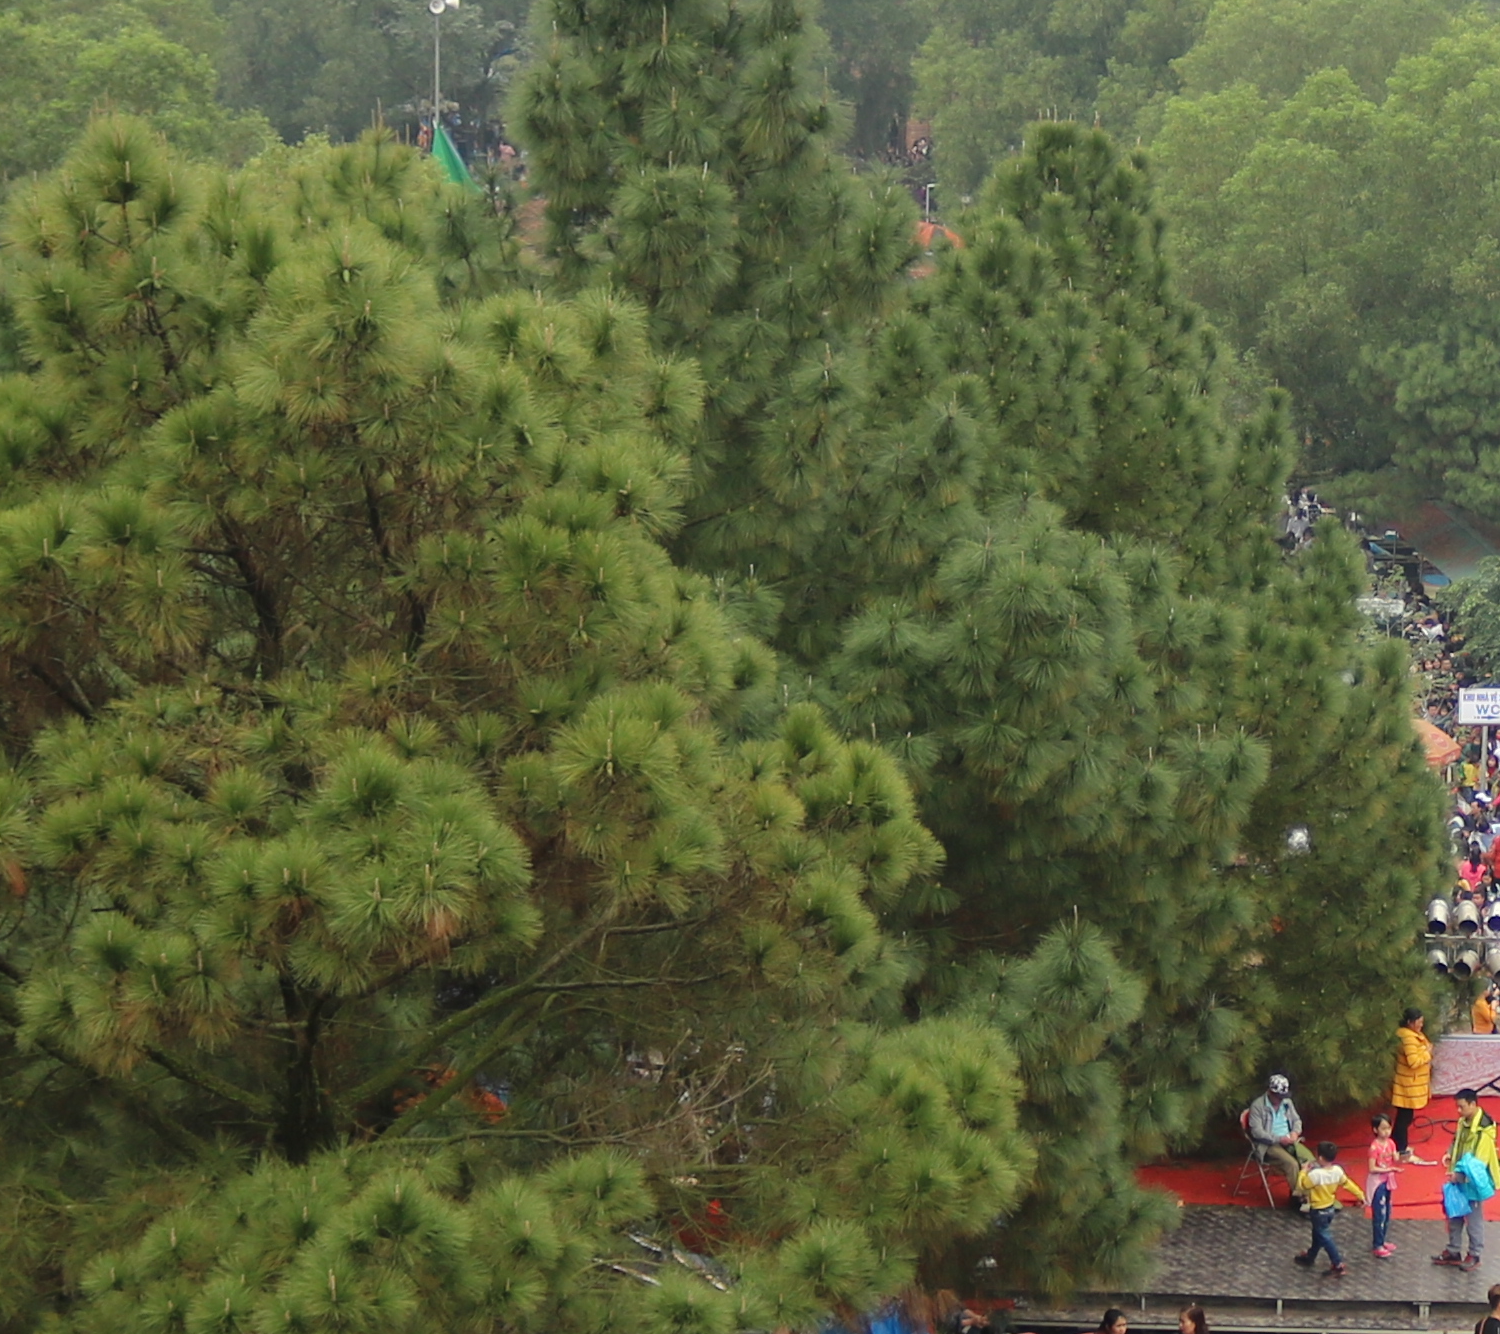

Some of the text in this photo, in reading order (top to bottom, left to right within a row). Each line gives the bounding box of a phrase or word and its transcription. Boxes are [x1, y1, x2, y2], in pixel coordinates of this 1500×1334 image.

[1463, 693, 1475, 702] KHU
[1476, 691, 1489, 702] NHÀ
[1490, 691, 1498, 703] VỆ
[1475, 704, 1500, 715] WC
